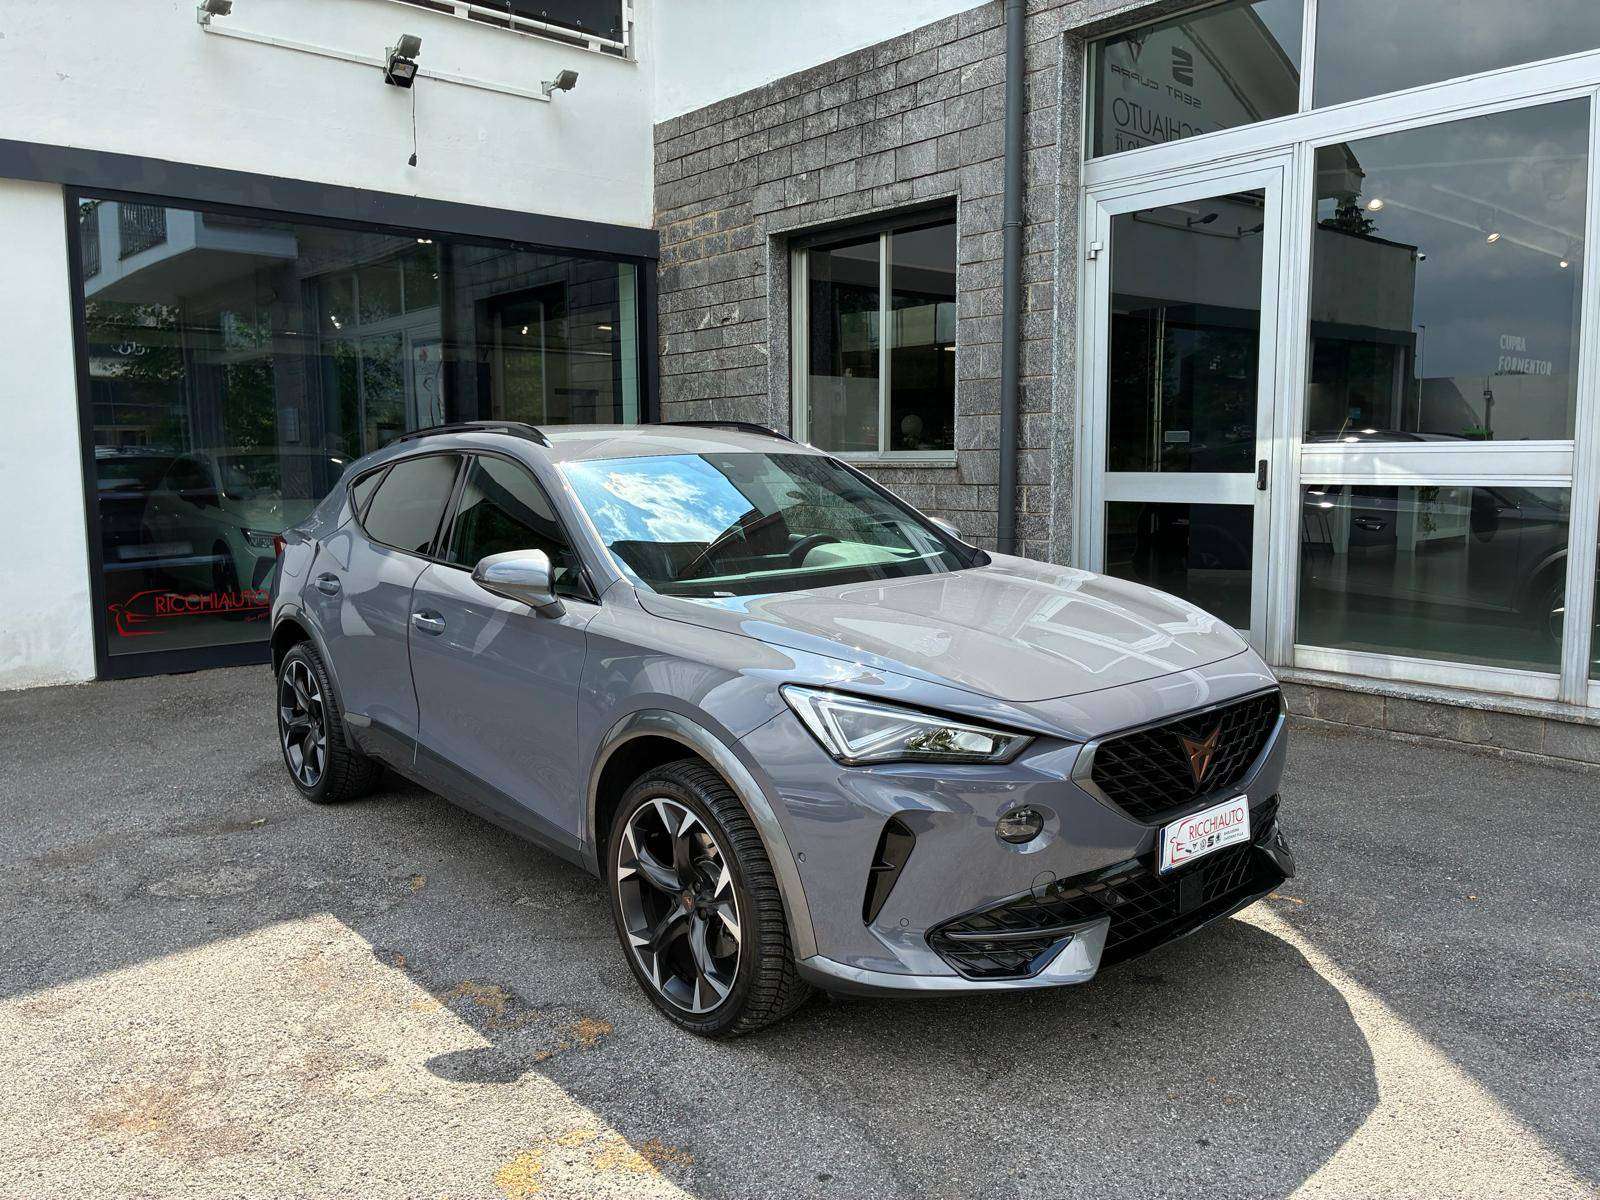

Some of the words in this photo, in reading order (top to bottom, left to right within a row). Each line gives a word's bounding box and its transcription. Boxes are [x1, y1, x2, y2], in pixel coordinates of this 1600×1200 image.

[1500, 334, 1526, 352] CUPRA
[155, 589, 269, 613] RICCHIAUTO
[1188, 807, 1244, 841] RICCHIAUTO
